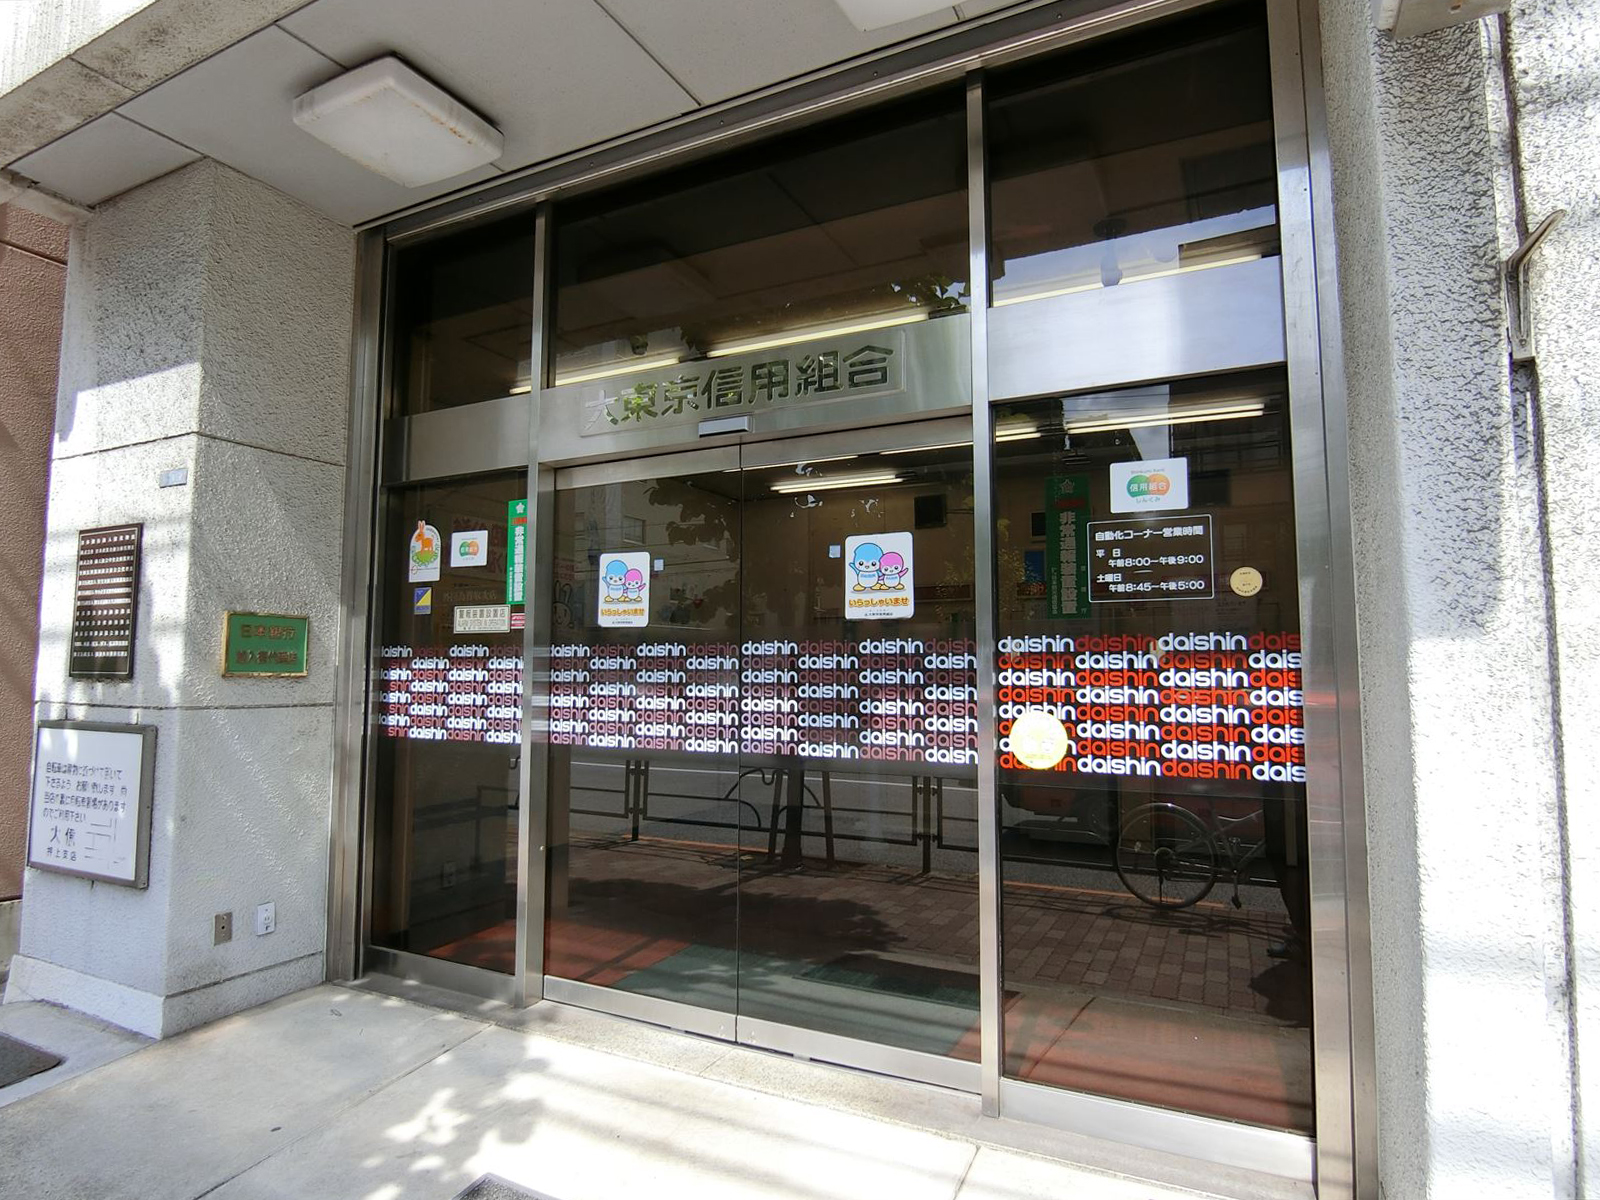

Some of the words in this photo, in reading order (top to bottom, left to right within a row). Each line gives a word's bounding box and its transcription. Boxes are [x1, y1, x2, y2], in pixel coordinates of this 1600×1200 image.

[584, 344, 894, 431] 大東京信用組合
[1130, 482, 1167, 493] 信用組合
[1095, 525, 1203, 541] 自動化コーナー営業時間
[1096, 573, 1122, 583] 土曜日
[849, 596, 909, 608] いらっしゃいませ
[601, 608, 644, 617] いらっしゃいませ
[637, 643, 686, 656] daishin
[742, 641, 798, 654] daishin
[859, 638, 923, 653] daishin
[998, 635, 1074, 652] daishin
[1158, 632, 1247, 650] daishin
[450, 644, 489, 657] daishin
[412, 657, 449, 669] daishin
[590, 657, 636, 669] daishin
[687, 656, 739, 669] daishin
[799, 654, 858, 669] daishin
[1076, 651, 1158, 670] daishin
[449, 668, 488, 681] daishin
[637, 669, 686, 683] daishin
[742, 669, 798, 683] daishin
[859, 669, 924, 684] daishin
[999, 669, 1075, 686] daishin
[1159, 668, 1248, 688] daishin
[411, 680, 448, 692] daishin
[590, 682, 636, 696] daishin
[686, 683, 738, 697] daishin
[799, 683, 858, 699] daishin
[448, 692, 488, 705] daishin
[636, 696, 686, 709] daishin
[1076, 686, 1159, 705] daishin
[410, 704, 447, 716] daishin
[741, 697, 798, 712] daishin
[859, 699, 924, 715] daishin
[589, 708, 635, 722] daishin
[686, 710, 738, 725] daishin
[799, 712, 858, 728] daishin
[1160, 704, 1249, 724] daishin
[447, 716, 487, 729] daishin
[636, 722, 685, 736] daishin
[409, 727, 446, 740] daishin
[741, 725, 798, 740] daishin
[859, 729, 924, 746] daishin
[1077, 721, 1160, 741] daishin
[588, 734, 635, 748] daishin
[686, 738, 738, 753] daishin
[798, 741, 858, 758] daishin
[1161, 741, 1251, 762] daishin
[1077, 755, 1161, 777] daishin
